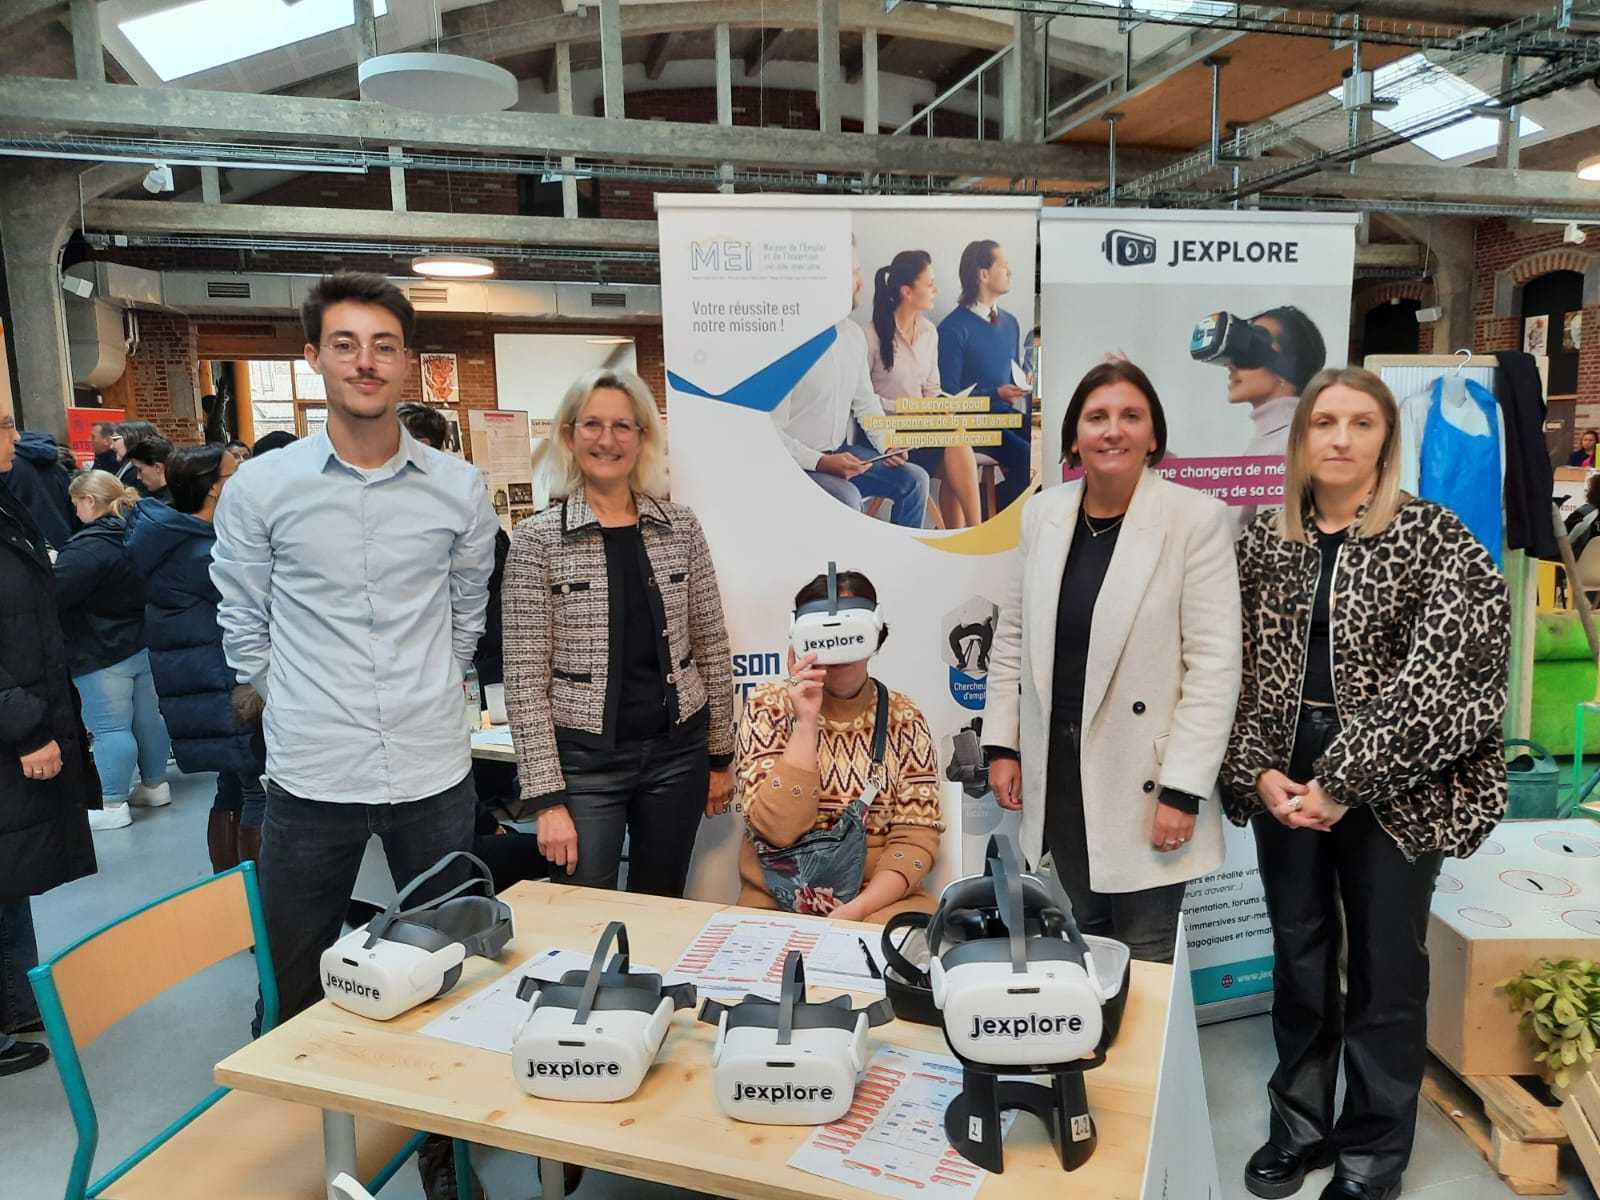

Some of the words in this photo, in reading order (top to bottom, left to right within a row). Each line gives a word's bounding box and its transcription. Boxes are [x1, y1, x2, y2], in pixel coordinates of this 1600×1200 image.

[690, 241, 752, 271] MEI
[1167, 240, 1298, 267] JEXPLORE
[692, 300, 725, 315] Votre
[729, 300, 779, 315] réussite
[782, 301, 800, 315] est
[692, 319, 726, 332] notre
[729, 318, 777, 332] mission
[1180, 465, 1242, 480] changera
[1245, 463, 1262, 476] de
[1264, 463, 1285, 476] mé
[1231, 485, 1247, 497] de
[1250, 486, 1264, 497] sa
[1267, 485, 1284, 496] ca
[1232, 897, 1260, 907] forums
[1190, 917, 1236, 931] immersives
[1235, 931, 1243, 939] et
